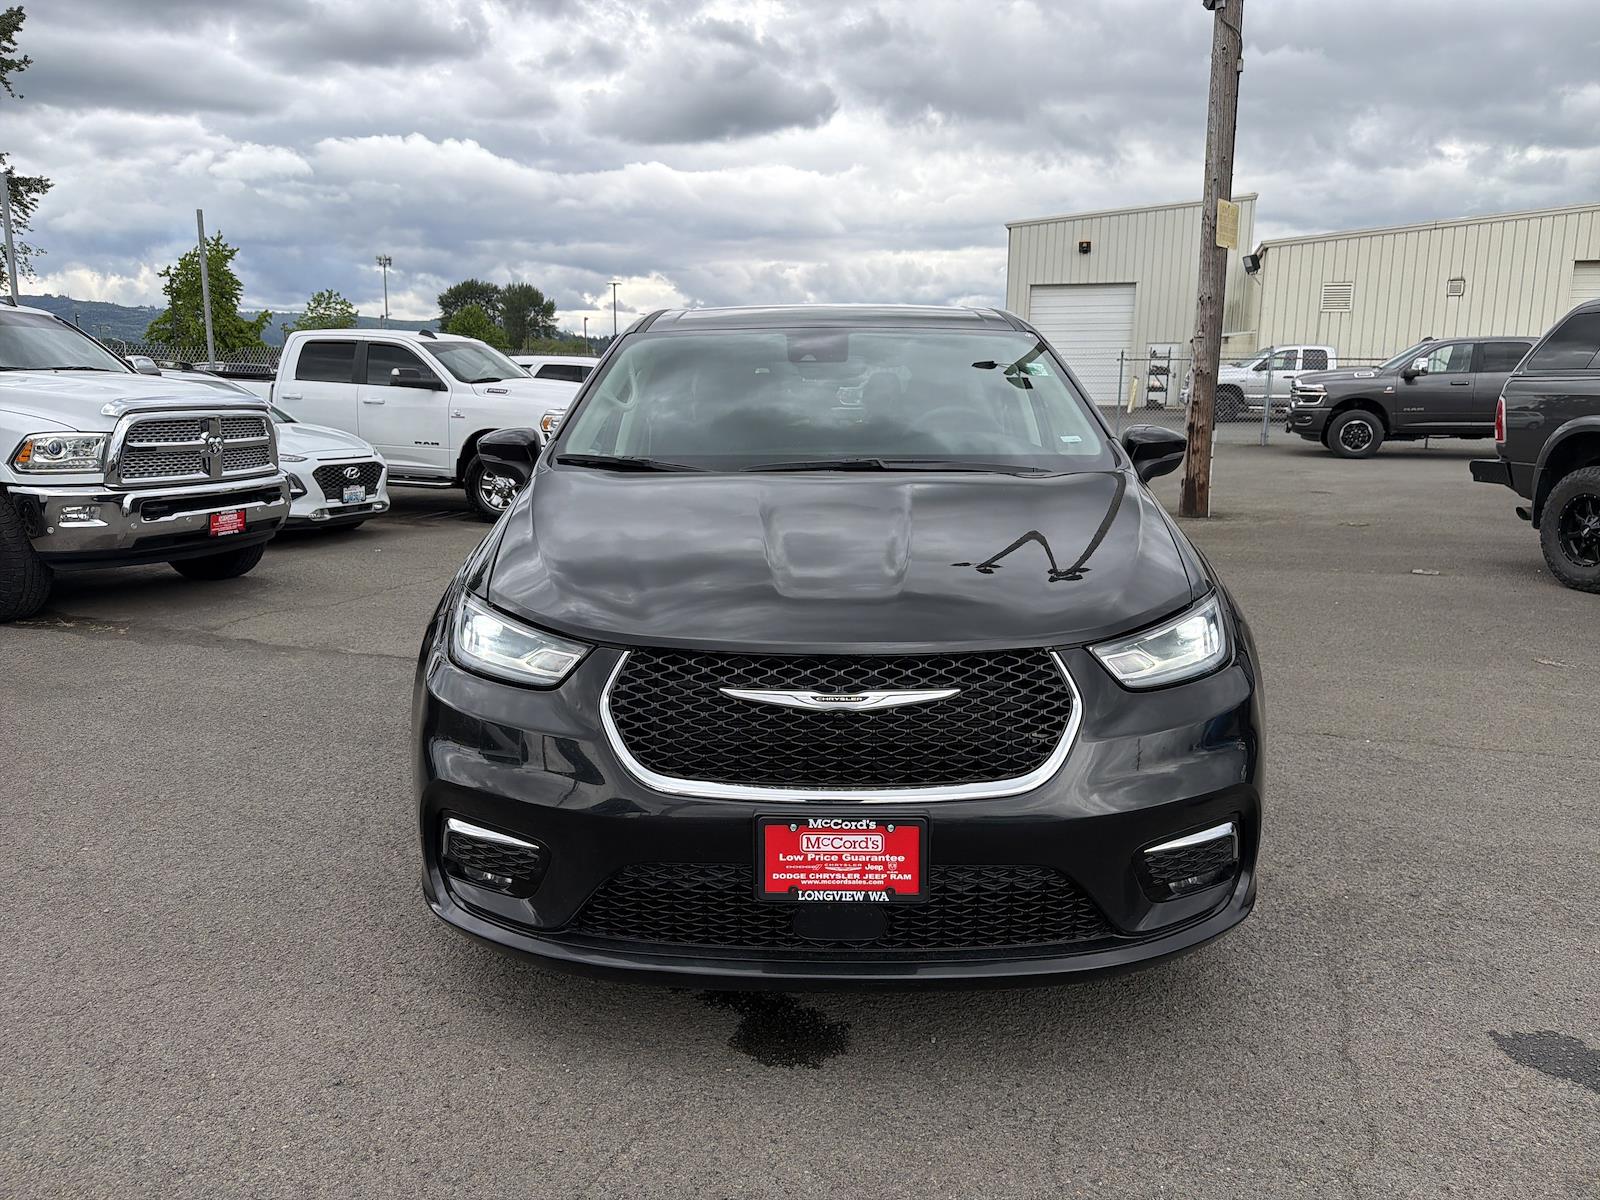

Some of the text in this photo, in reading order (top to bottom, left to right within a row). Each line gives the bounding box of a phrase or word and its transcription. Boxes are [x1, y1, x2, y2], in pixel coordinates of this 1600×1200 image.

[808, 819, 877, 830] McCord's
[805, 836, 880, 850] McCord's
[779, 853, 906, 862] Low Price Guarantee
[864, 863, 884, 872] Jeep
[797, 890, 890, 902] LONGVIEW WA
